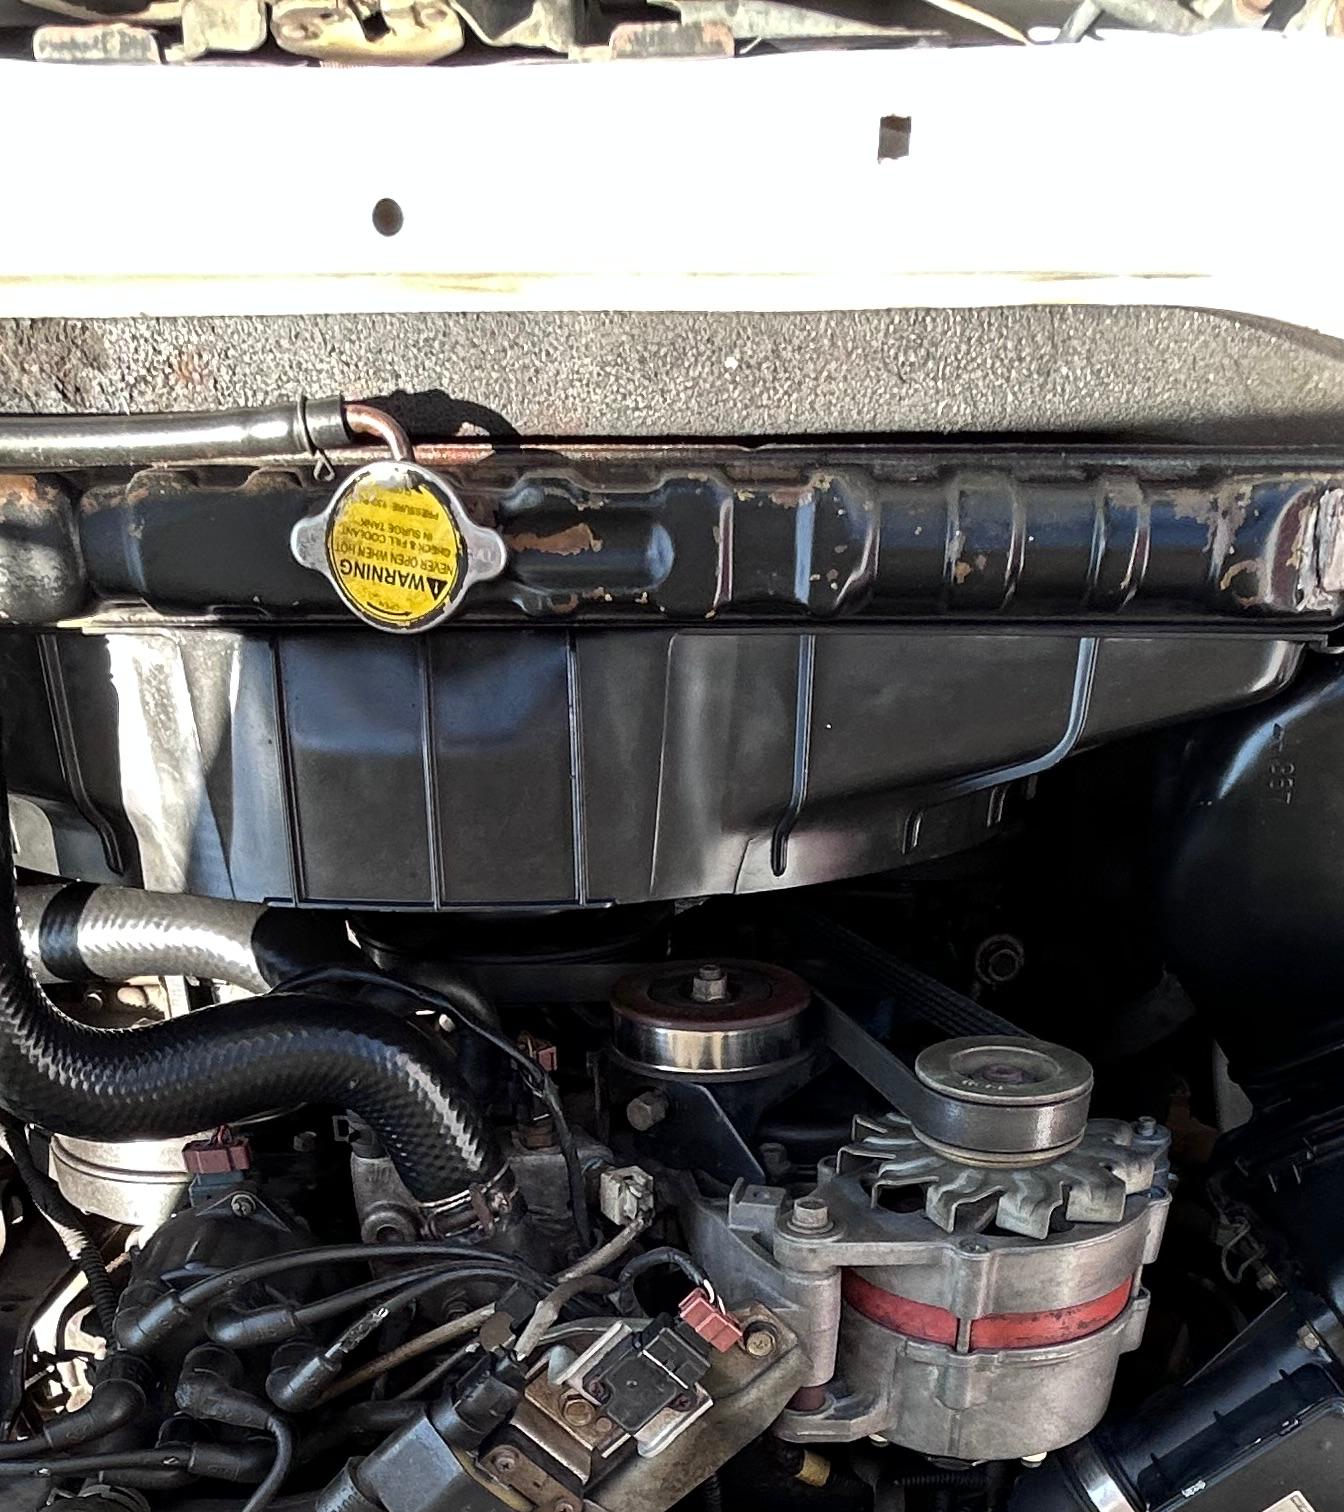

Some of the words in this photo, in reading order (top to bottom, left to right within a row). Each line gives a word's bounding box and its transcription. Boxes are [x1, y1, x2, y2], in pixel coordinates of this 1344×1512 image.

[359, 518, 385, 533] TANK
[340, 525, 386, 544] COOLANT
[387, 535, 407, 549] FILL
[422, 531, 433, 542] IN
[334, 542, 356, 555] HOT
[357, 546, 388, 561] WHEN
[418, 542, 451, 557] CHECK
[390, 552, 418, 568] OPEN
[420, 559, 454, 575] NEVER
[339, 559, 425, 593] WARNING
